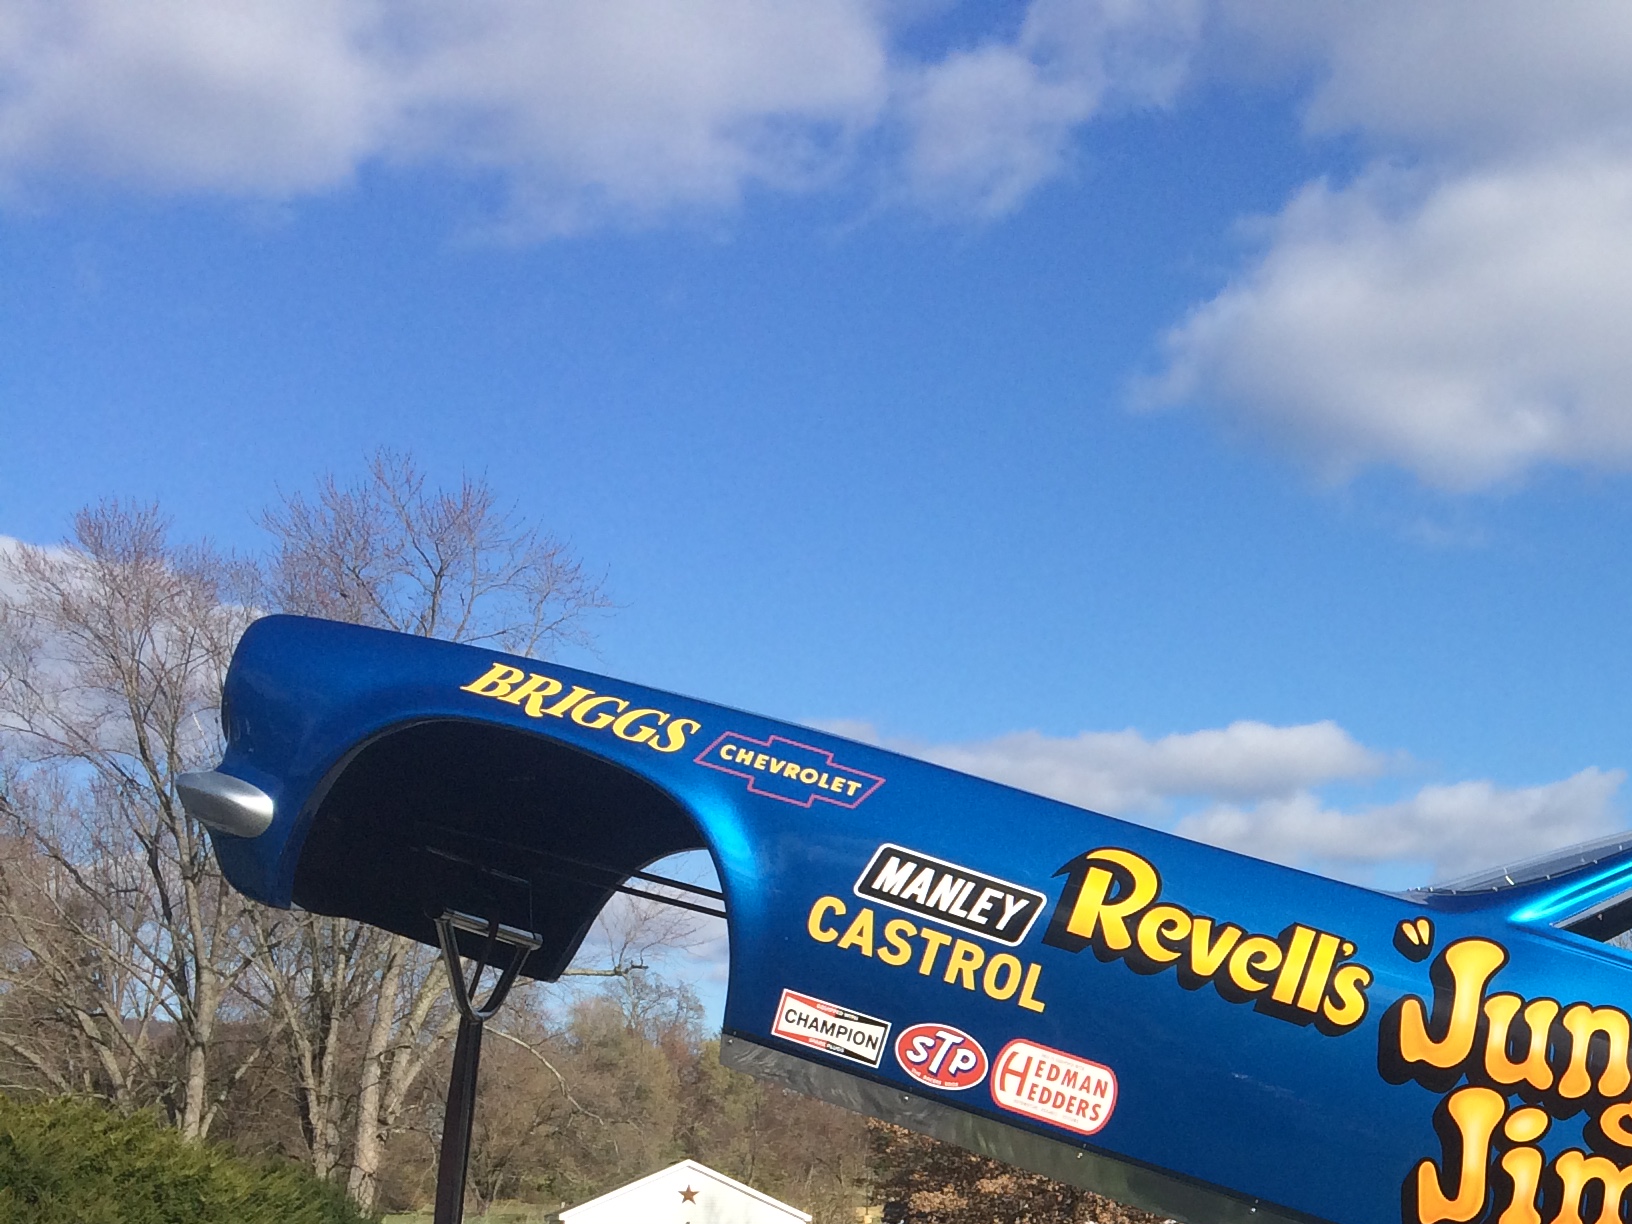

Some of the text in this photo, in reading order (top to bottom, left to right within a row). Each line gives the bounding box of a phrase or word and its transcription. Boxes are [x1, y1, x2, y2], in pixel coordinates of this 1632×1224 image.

[460, 662, 701, 753] BRIGGS
[719, 744, 863, 798] CHEVROLET
[878, 859, 1030, 931] MANLEY
[807, 896, 1046, 1013] CASTROL
[1064, 848, 1375, 1030] Revell's
[784, 1008, 879, 1051] CHAMPION
[905, 1030, 978, 1076] STP
